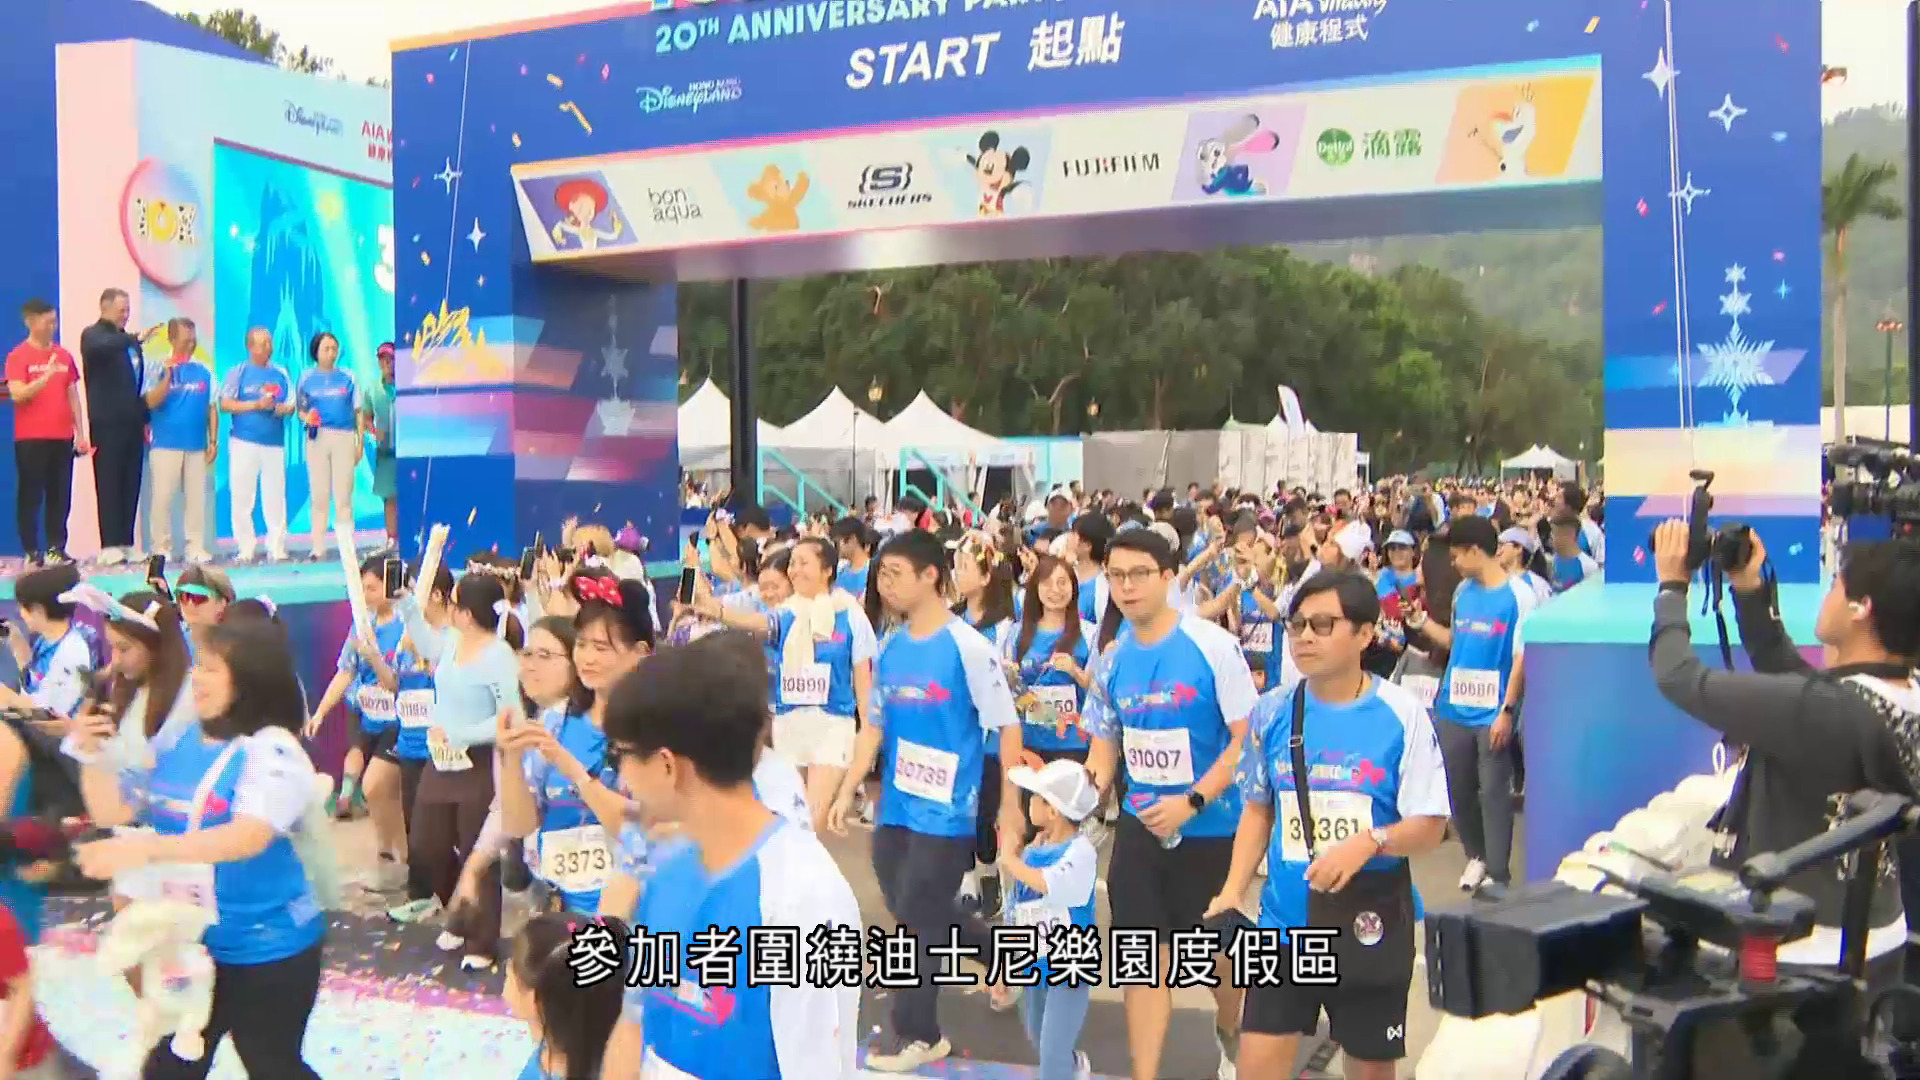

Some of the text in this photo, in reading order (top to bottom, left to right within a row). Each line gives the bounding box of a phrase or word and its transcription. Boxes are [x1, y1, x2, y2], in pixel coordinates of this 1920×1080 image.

[655, 0, 950, 53] 20TH ANNIVERSARY
[1027, 12, 1126, 72] 起點
[845, 31, 1002, 90] START
[1063, 152, 1160, 178] FUJIFILM
[648, 187, 687, 206] bon
[653, 203, 702, 224] aqua
[1127, 747, 1181, 770] 31007
[1289, 816, 1360, 841] 3361
